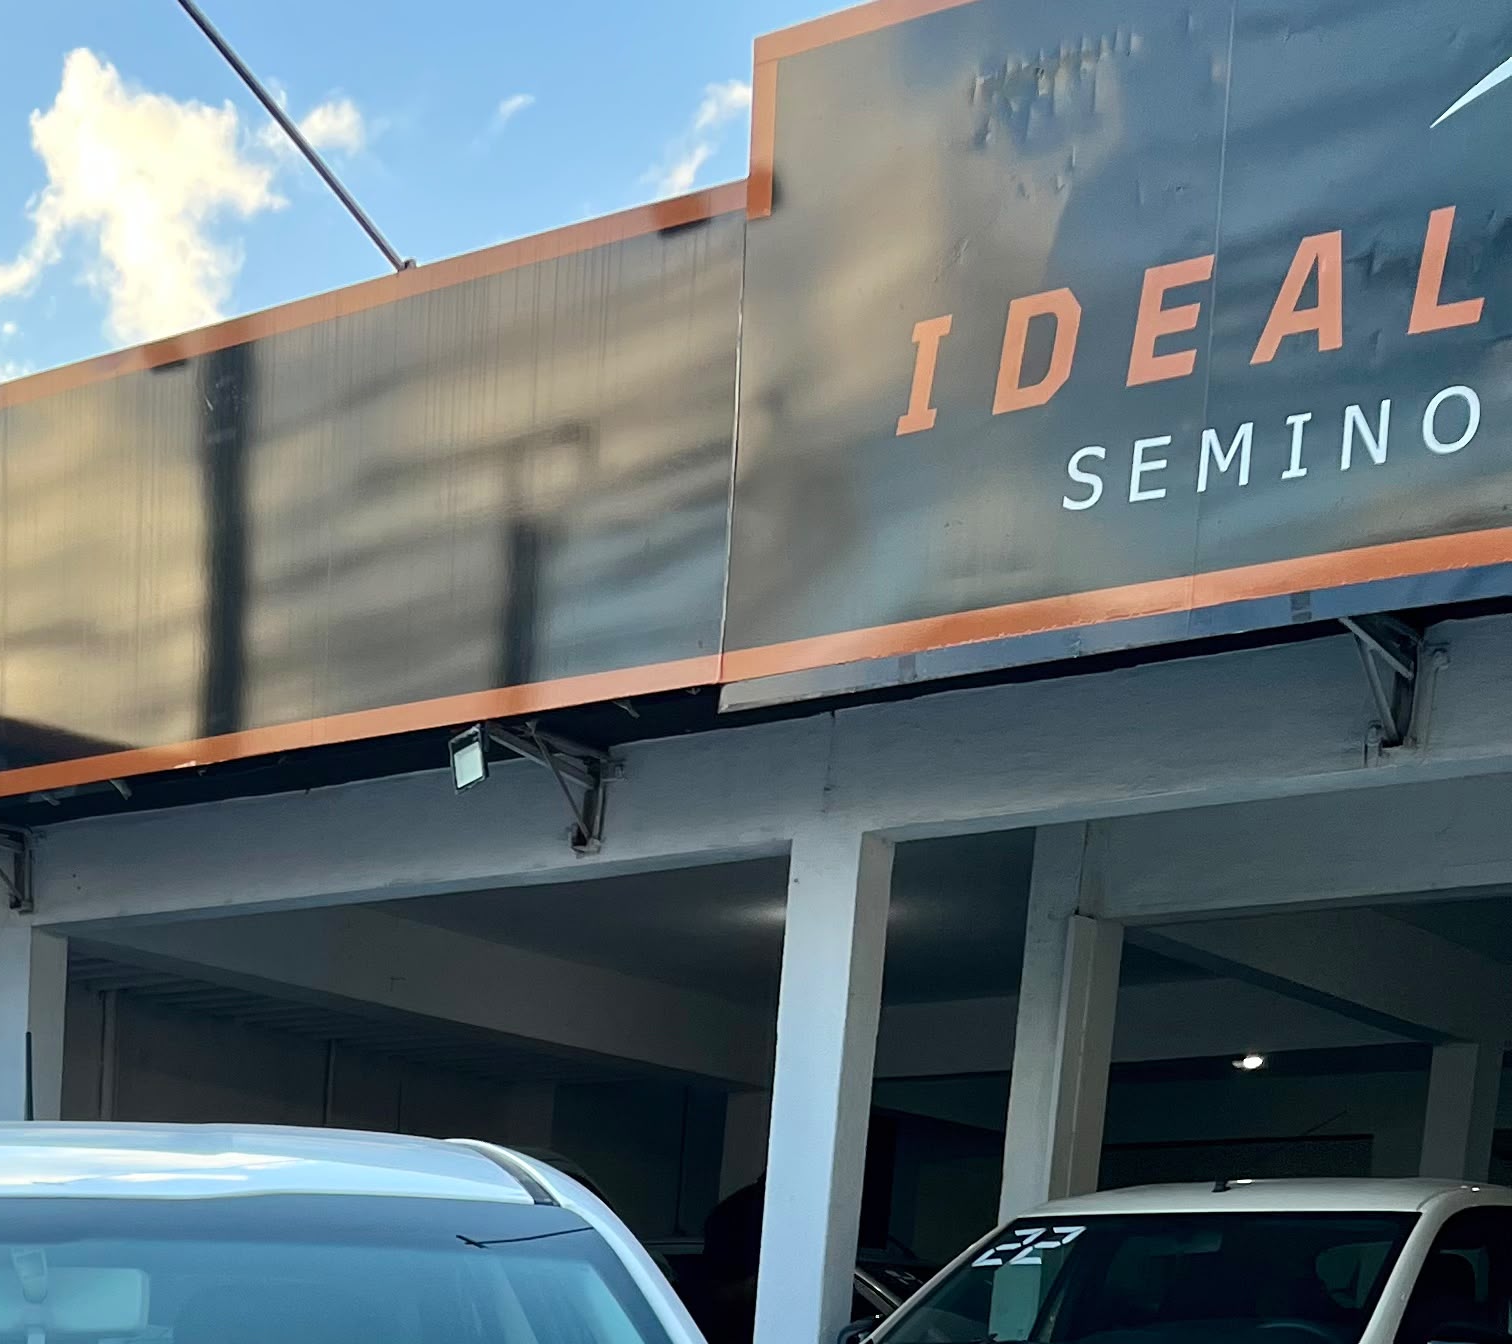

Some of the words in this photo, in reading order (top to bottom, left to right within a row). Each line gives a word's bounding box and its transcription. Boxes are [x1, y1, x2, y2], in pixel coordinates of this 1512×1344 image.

[895, 205, 1486, 437] IDEAL
[1061, 384, 1481, 511] SEMINO
[971, 1225, 1087, 1267] 22
